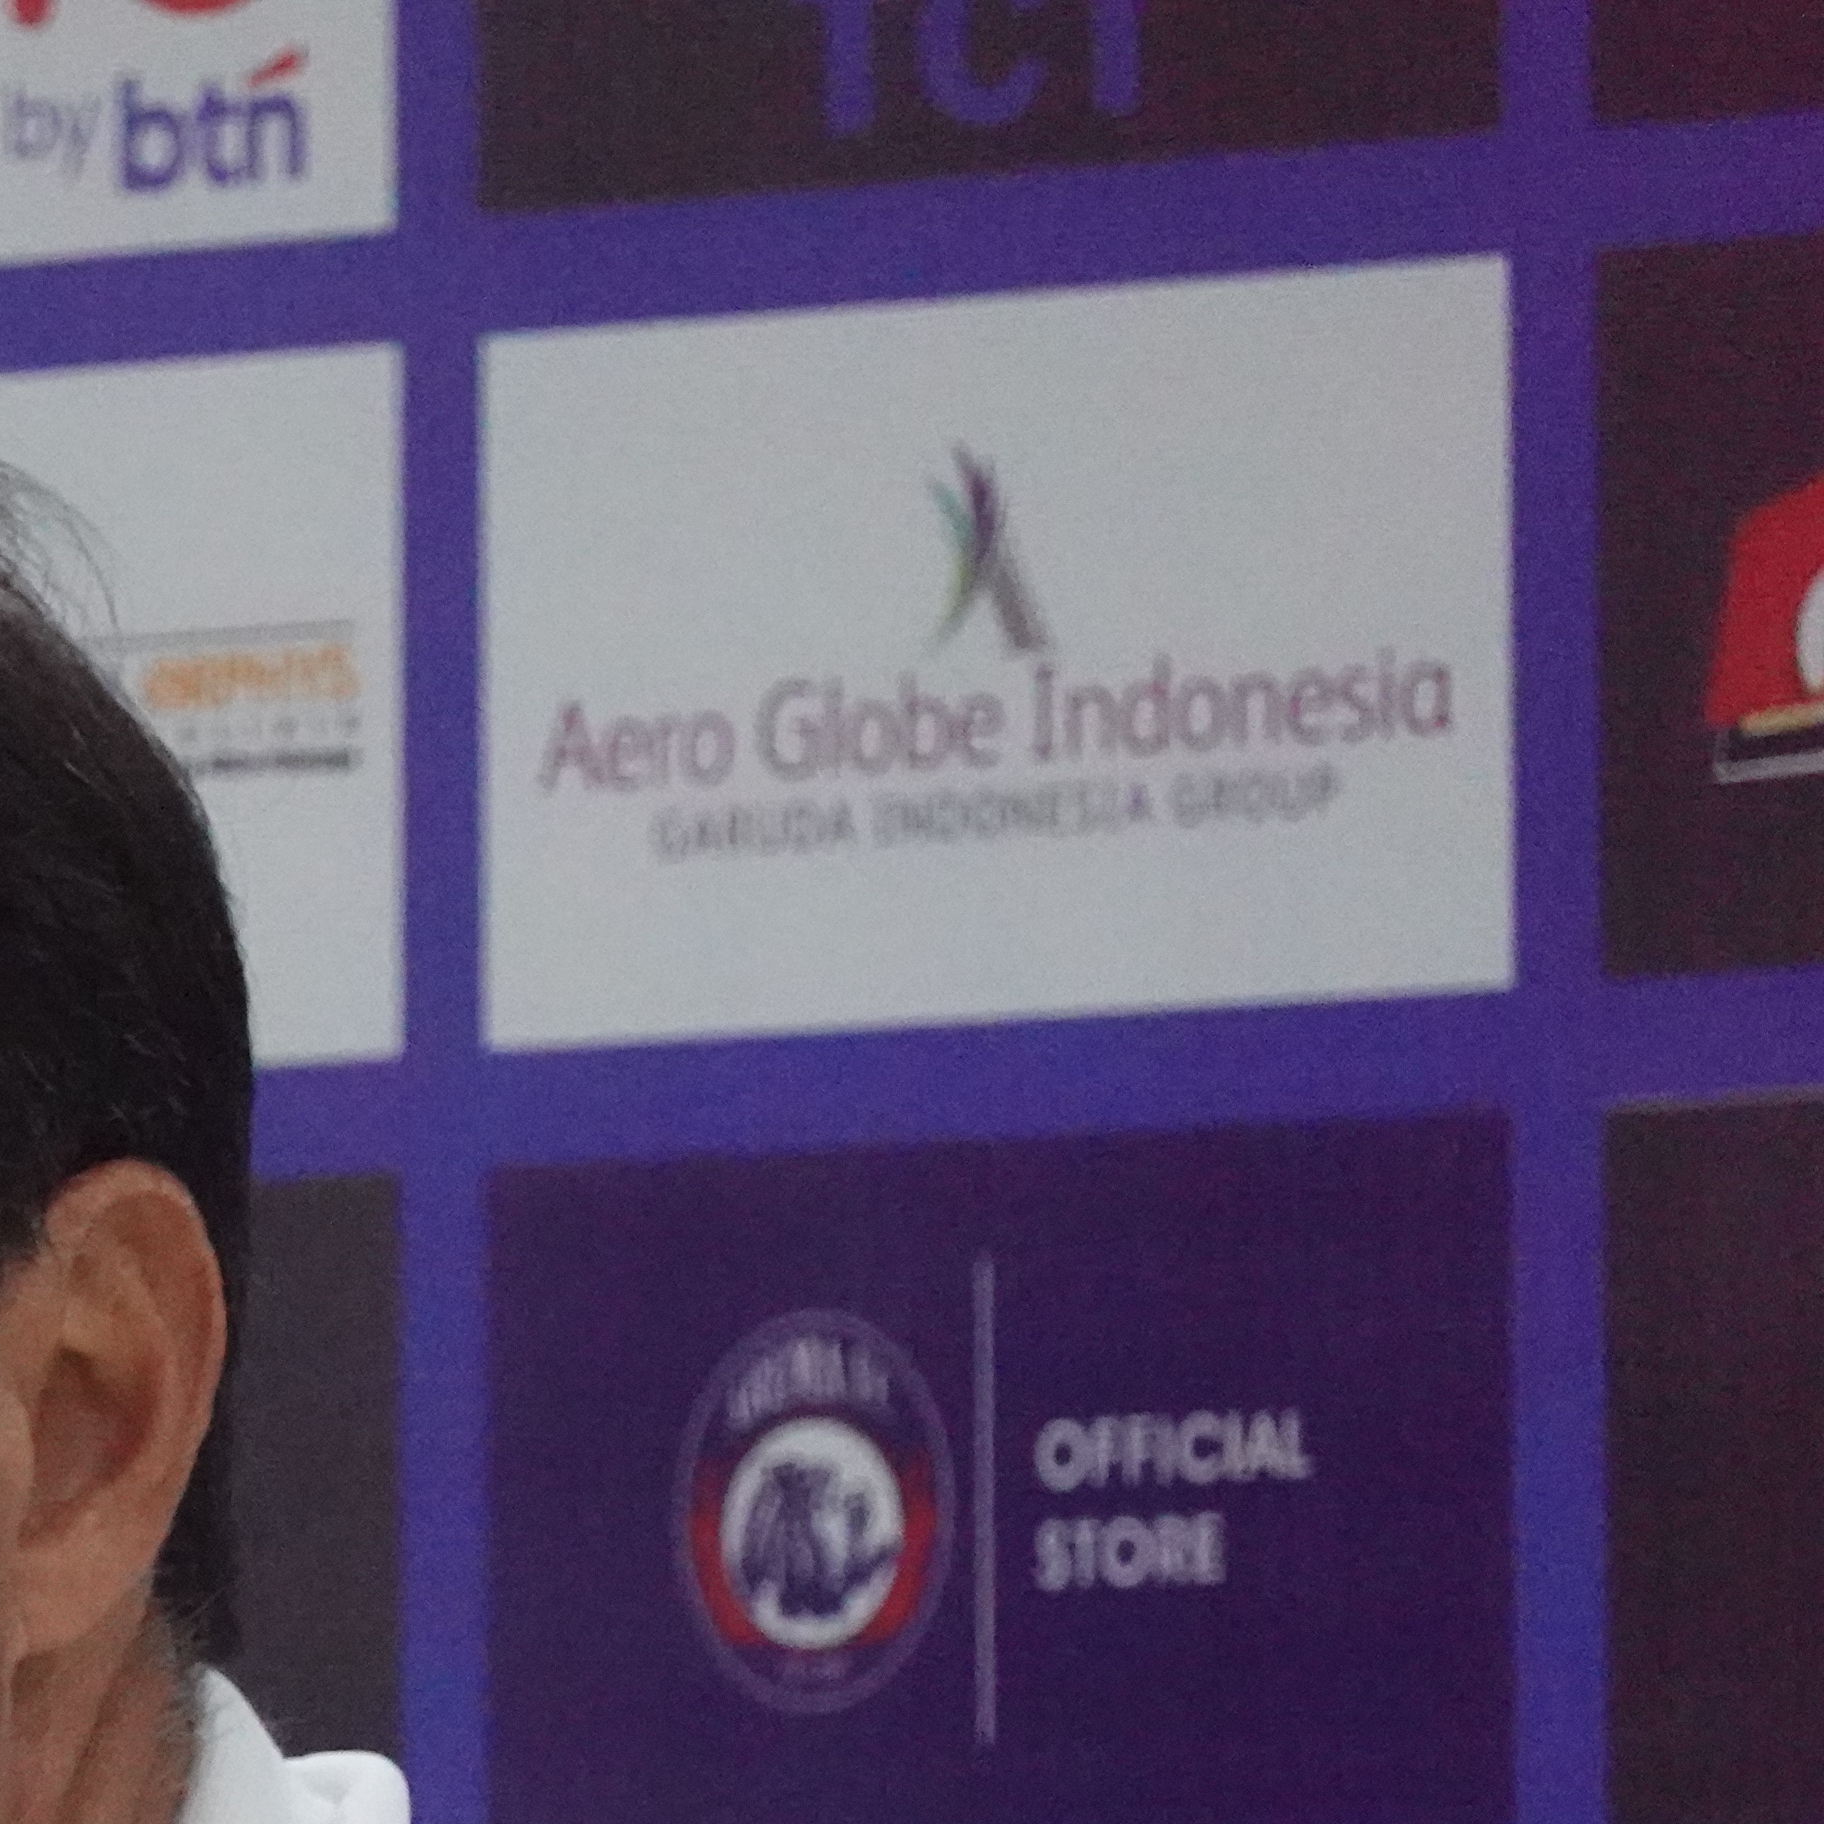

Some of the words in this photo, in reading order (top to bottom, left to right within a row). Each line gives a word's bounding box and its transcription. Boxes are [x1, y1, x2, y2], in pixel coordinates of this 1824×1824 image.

[537, 697, 735, 795] Aero
[754, 669, 1006, 783] Globe
[1033, 648, 1455, 765] Indonesia
[1033, 1408, 1311, 1492] OFFICIAL
[1033, 1513, 1226, 1591] STORE
